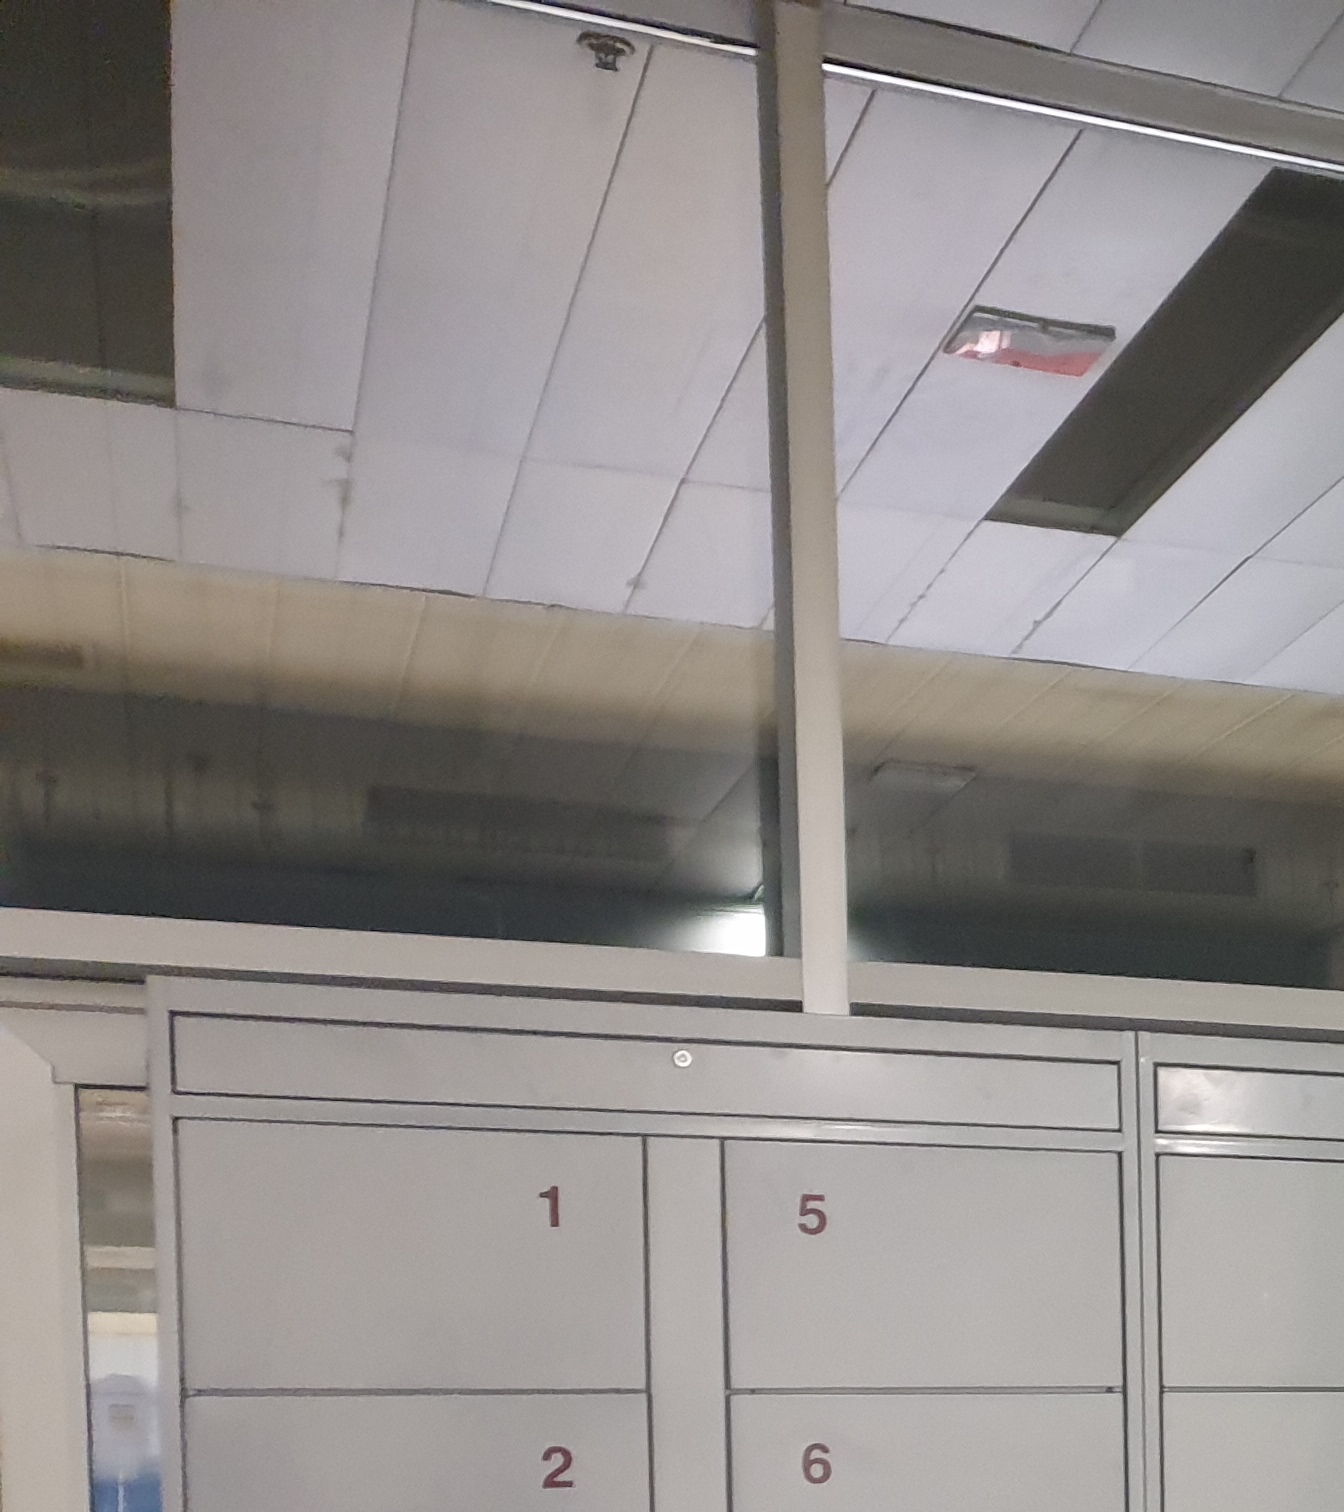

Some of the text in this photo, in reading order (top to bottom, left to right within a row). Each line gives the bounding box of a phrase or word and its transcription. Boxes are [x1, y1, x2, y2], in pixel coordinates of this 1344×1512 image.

[538, 1186, 560, 1228] 1
[798, 1194, 828, 1236] 5
[542, 1447, 577, 1489] 2
[802, 1443, 832, 1485] 6
